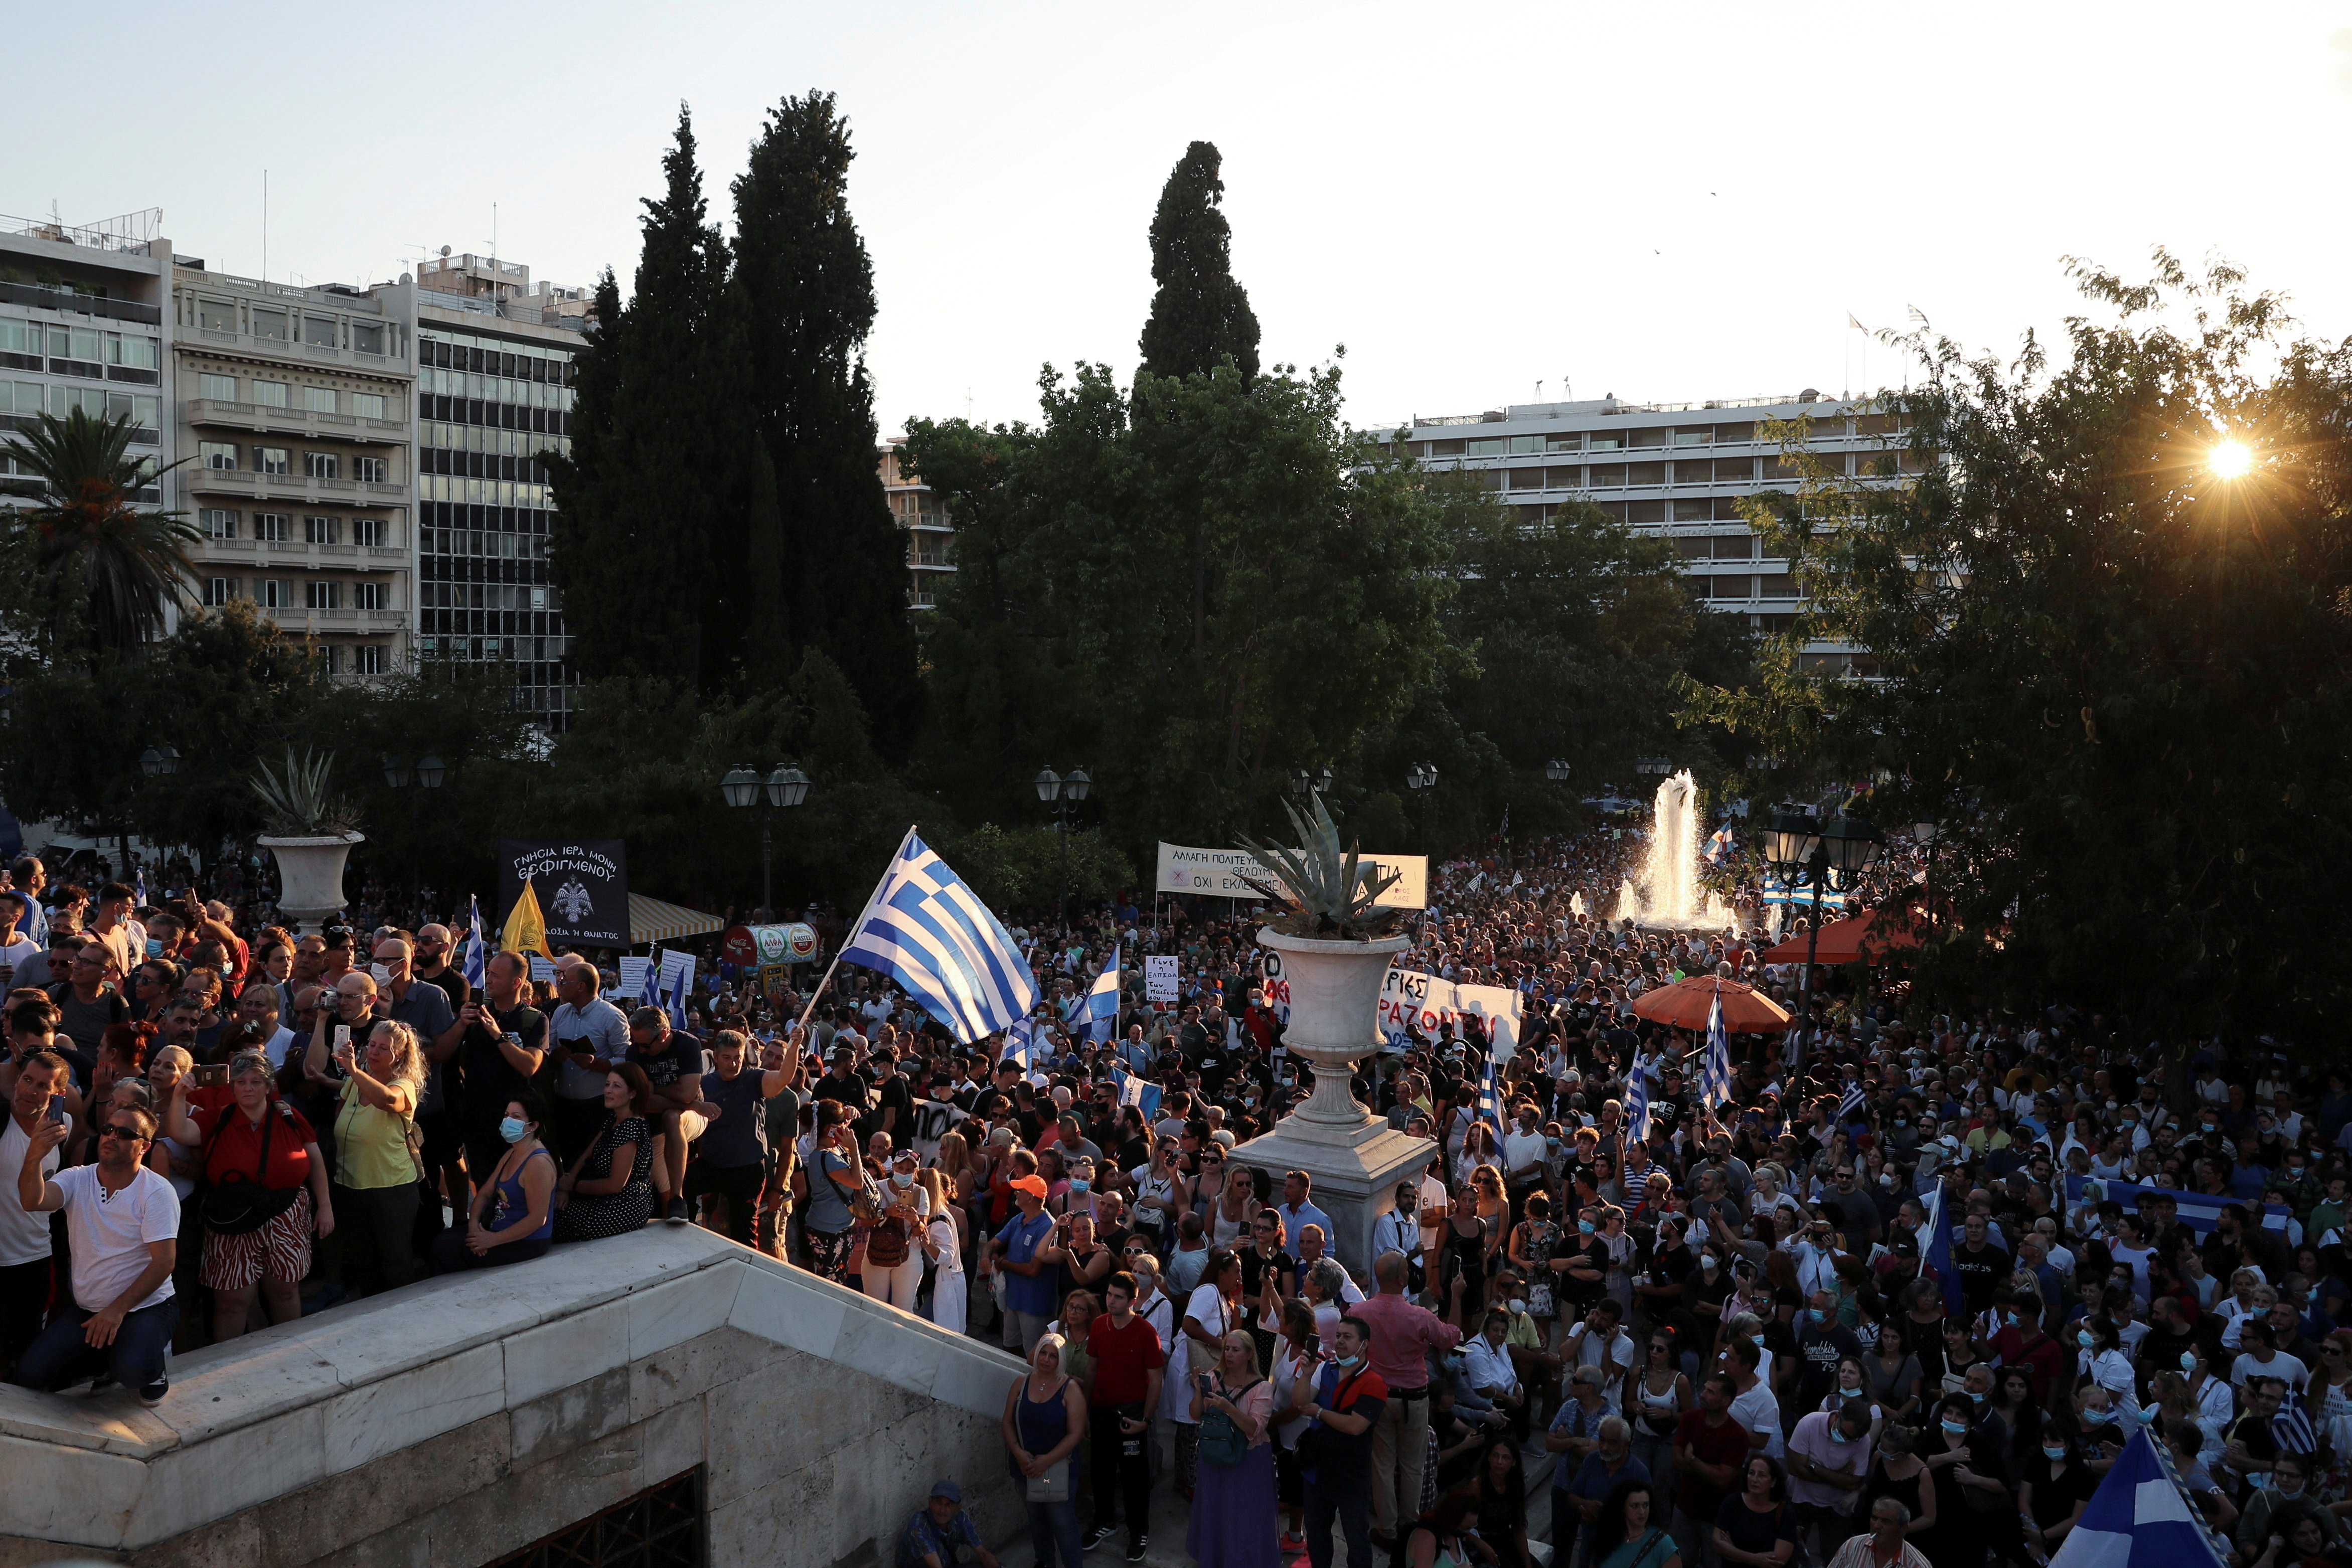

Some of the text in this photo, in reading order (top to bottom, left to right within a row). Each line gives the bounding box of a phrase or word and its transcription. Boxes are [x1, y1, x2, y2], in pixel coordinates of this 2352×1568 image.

[563, 846, 585, 856] ΙΕΡΑ
[589, 850, 617, 872] ΜΟΝΗ
[1173, 850, 1208, 862] ΑΛΛΑΓΗ
[1194, 876, 1212, 888] ΟΧΙ
[764, 938, 782, 947] ΑΛΦΑ
[1822, 1361, 1837, 1372] 79
